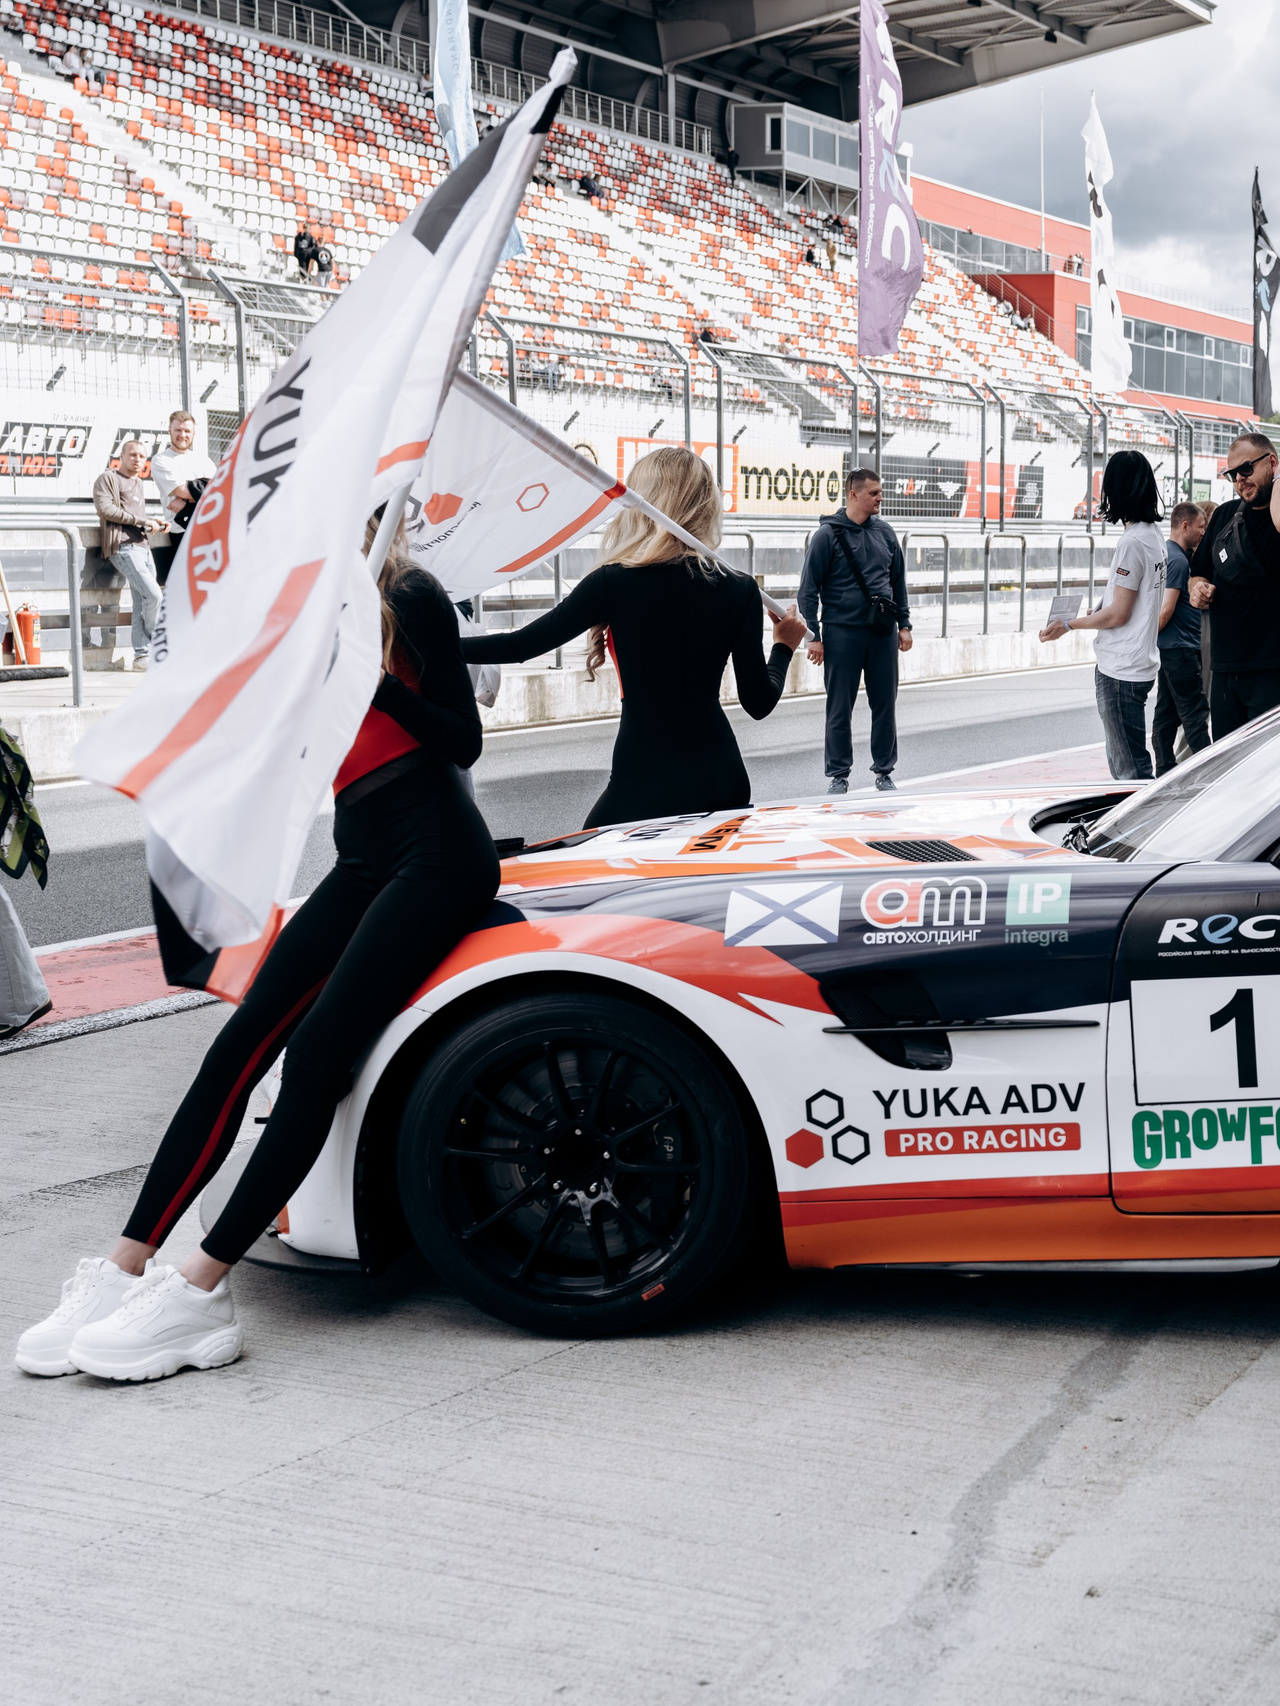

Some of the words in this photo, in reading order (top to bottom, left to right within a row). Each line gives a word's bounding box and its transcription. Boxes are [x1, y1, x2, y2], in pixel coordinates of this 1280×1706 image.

[1, 425, 86, 456] АВТО
[1017, 882, 1063, 915] IP
[1004, 928, 1069, 947] integra
[1209, 988, 1258, 1088] 1
[872, 1086, 991, 1120] YUKA
[1001, 1082, 1086, 1115] ADV
[899, 1131, 954, 1153] PRO
[963, 1127, 1067, 1150] RACING
